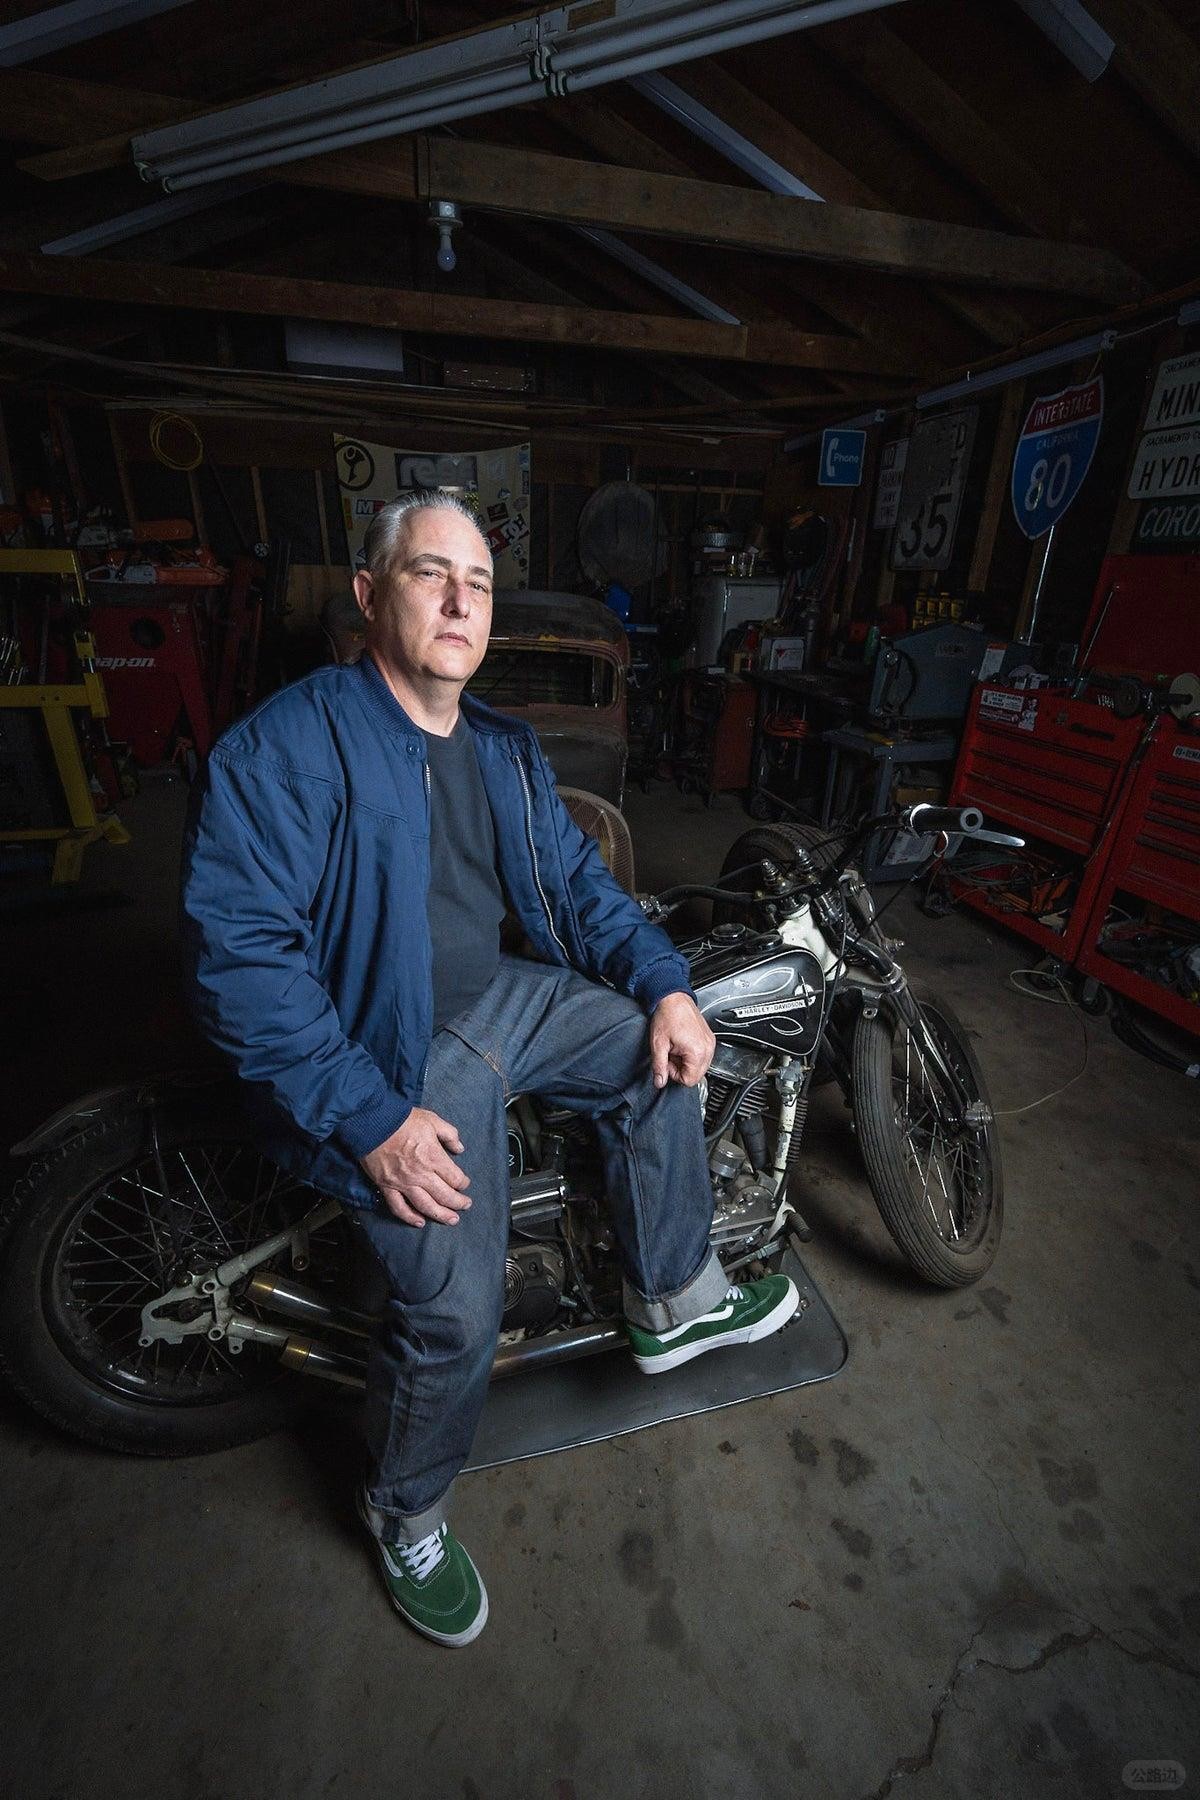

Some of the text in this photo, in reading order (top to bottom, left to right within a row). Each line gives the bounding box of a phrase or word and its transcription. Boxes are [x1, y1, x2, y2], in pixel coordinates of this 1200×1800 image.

[1033, 391, 1095, 427] INTERSTATE
[1156, 382, 1200, 421] MIN
[1145, 431, 1190, 448] SACRAMENTO
[833, 452, 860, 464] Phone
[1025, 453, 1071, 511] 80
[900, 493, 952, 558] 35
[1139, 503, 1200, 538] CORO
[95, 657, 155, 670] nap-on
